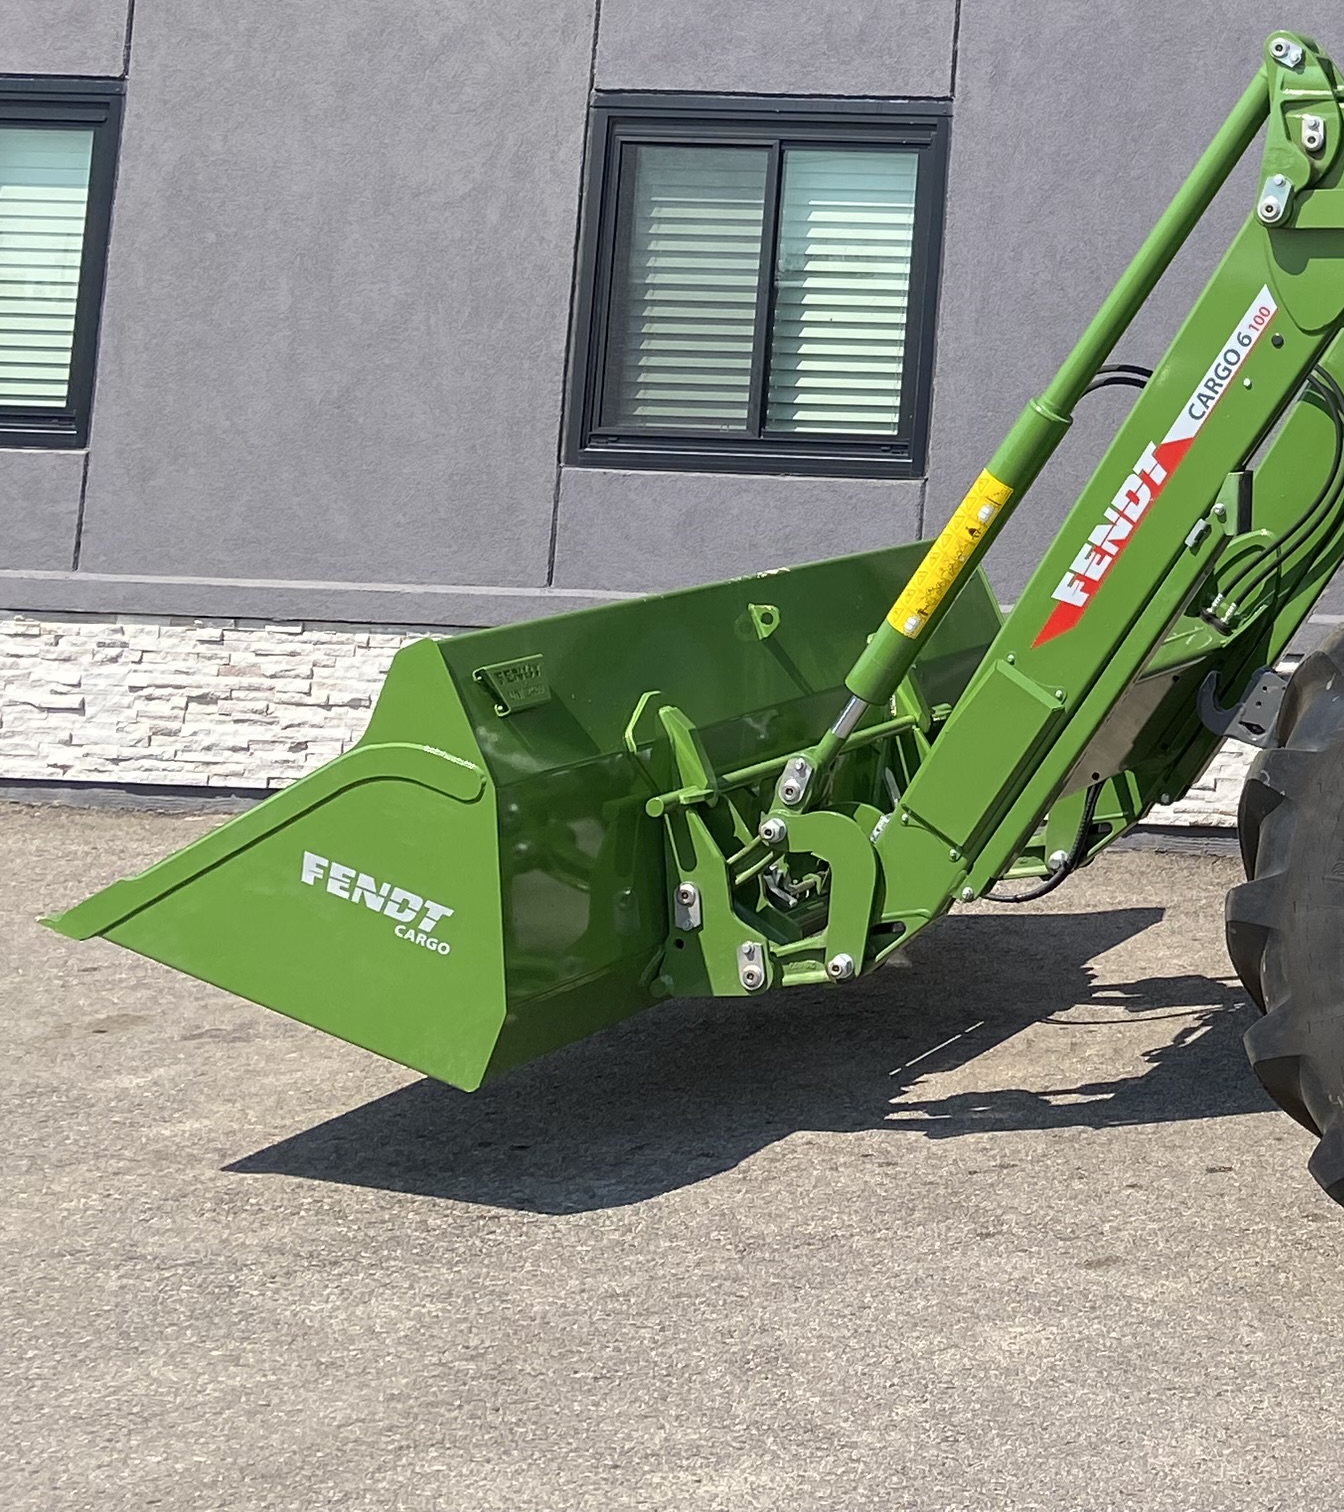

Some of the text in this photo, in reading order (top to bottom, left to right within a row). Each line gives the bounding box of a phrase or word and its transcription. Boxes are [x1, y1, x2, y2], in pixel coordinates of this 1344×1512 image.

[1050, 303, 1272, 610] FENDT CARGO 6 100
[301, 850, 455, 955] FENDT CARGO
